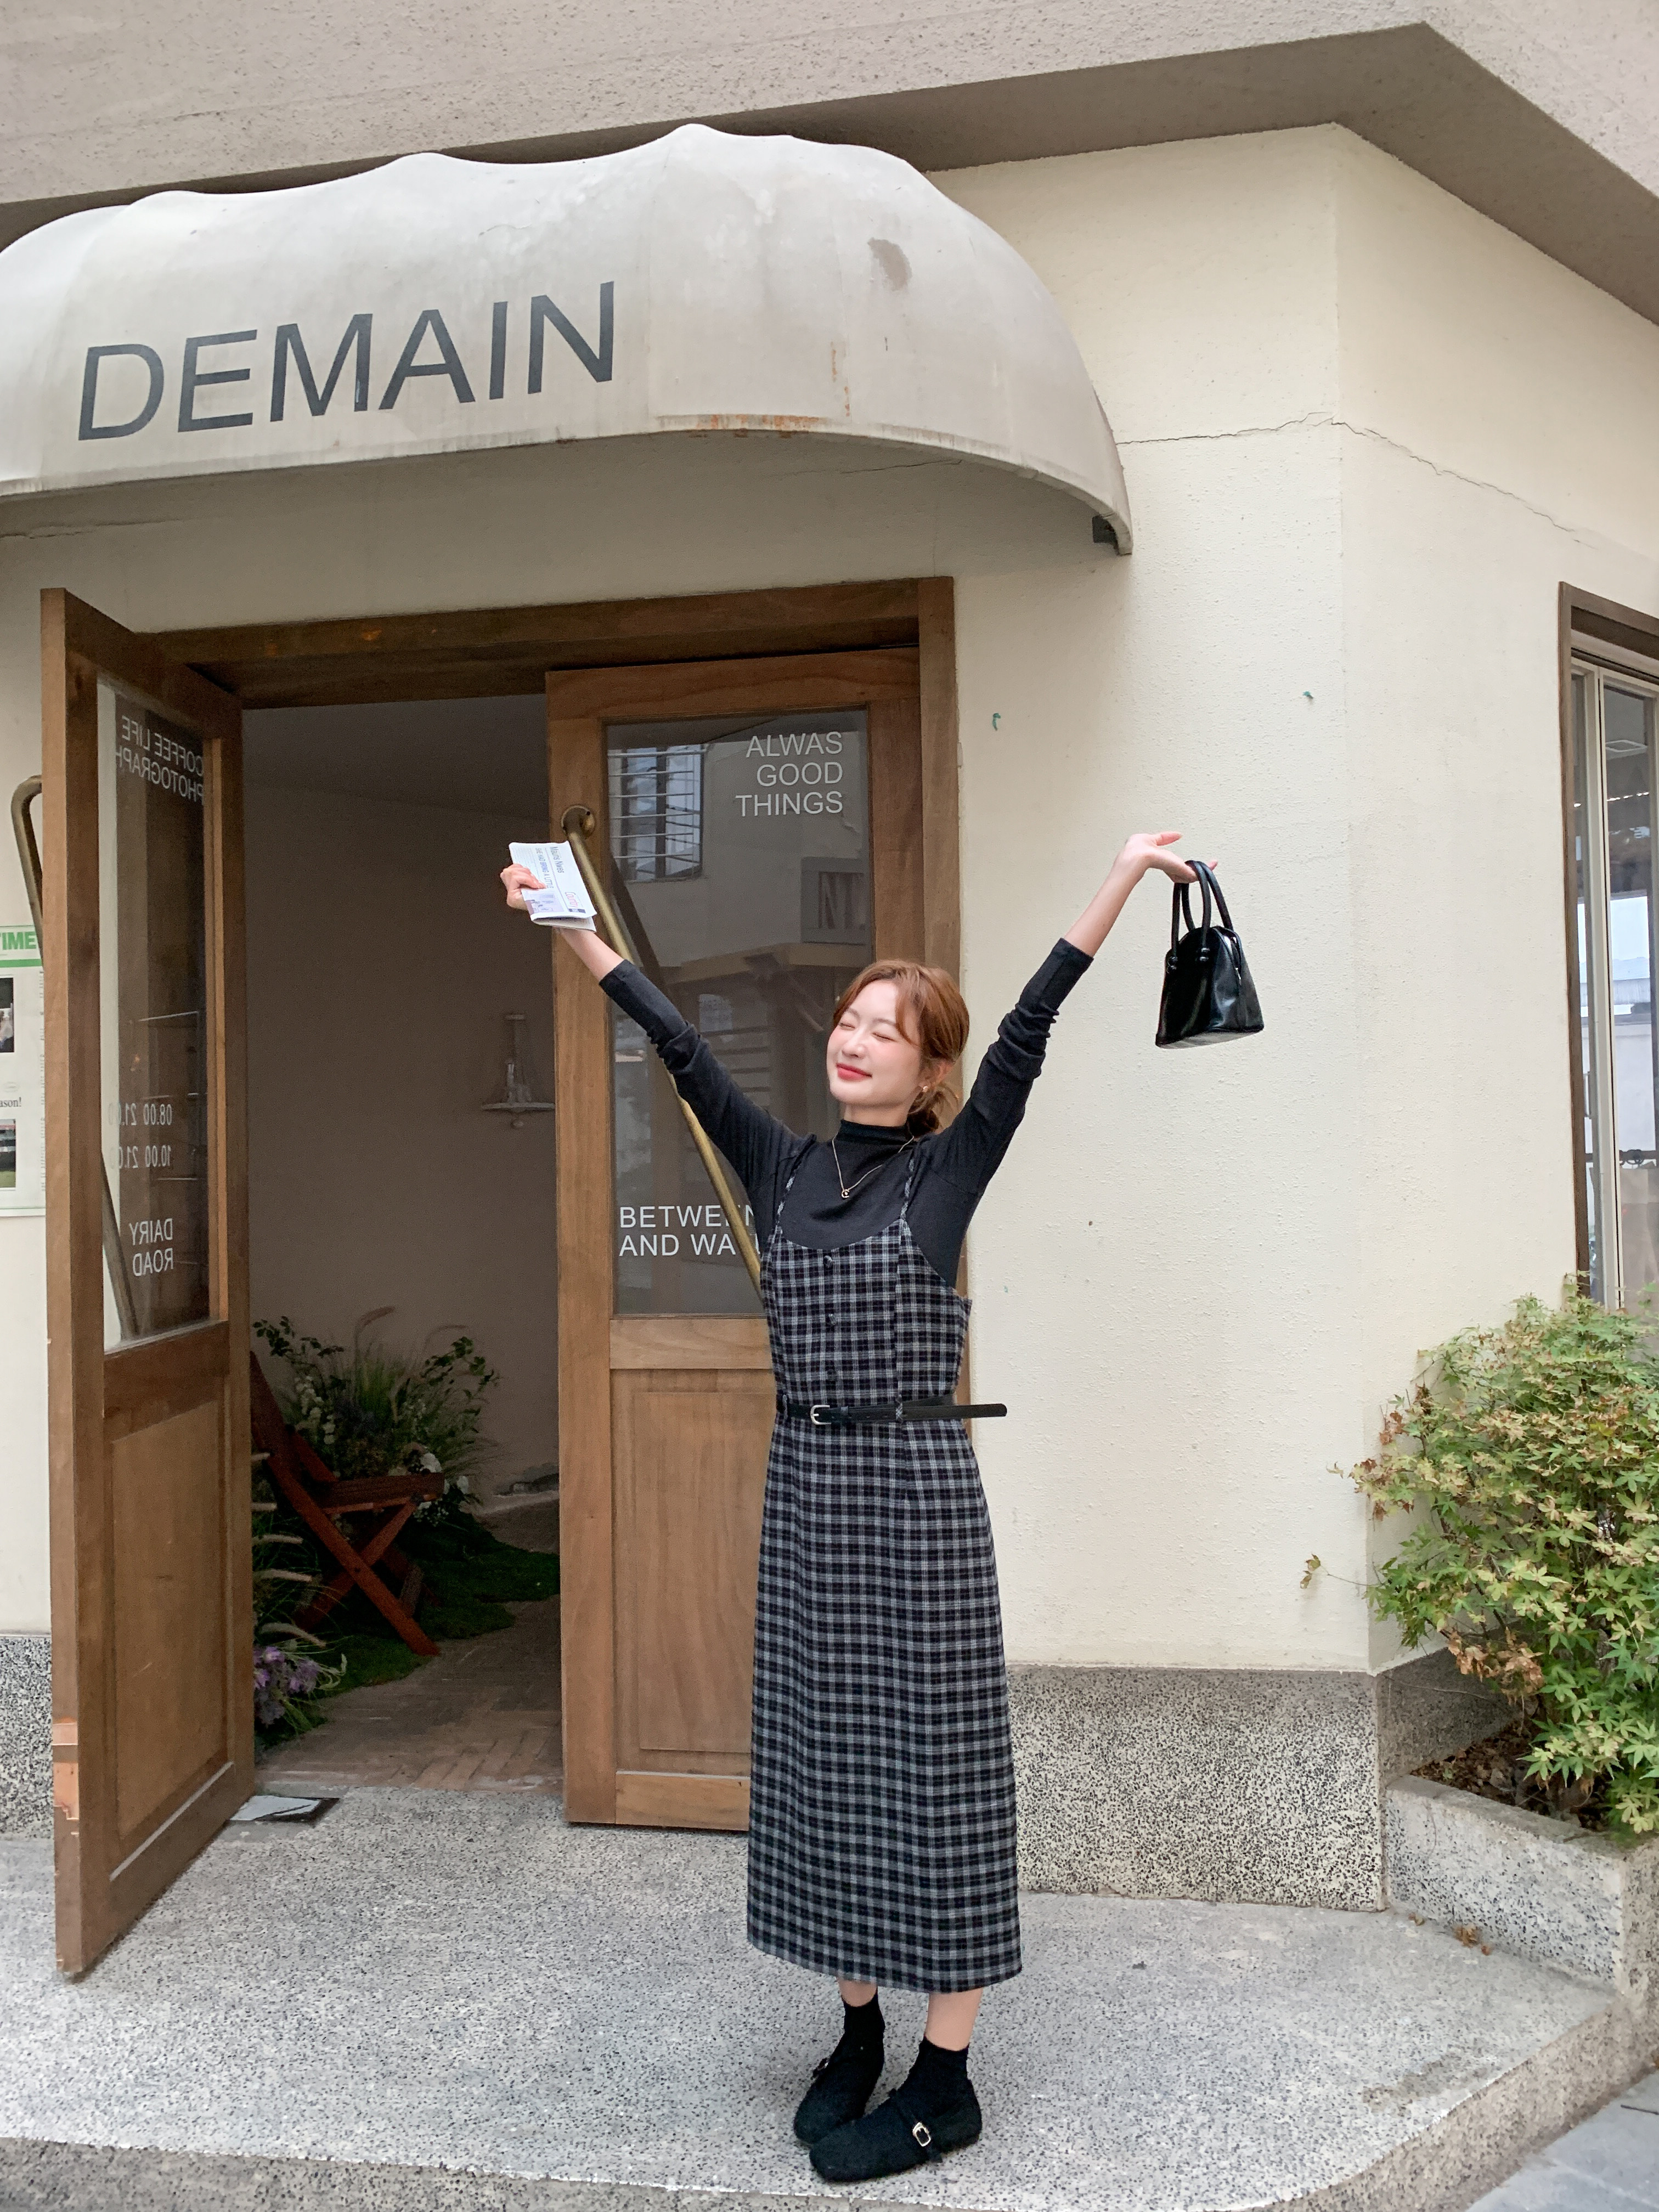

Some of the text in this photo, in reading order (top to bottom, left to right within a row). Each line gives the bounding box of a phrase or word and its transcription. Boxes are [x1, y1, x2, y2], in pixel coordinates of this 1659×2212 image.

[77, 280, 615, 441] DEMAIN
[746, 731, 842, 758] ALWAS
[757, 761, 843, 787] GOOD
[735, 791, 843, 817] THINGS
[0, 932, 37, 950] IME
[620, 1205, 754, 1228] BETWEN
[619, 1234, 679, 1256] AND
